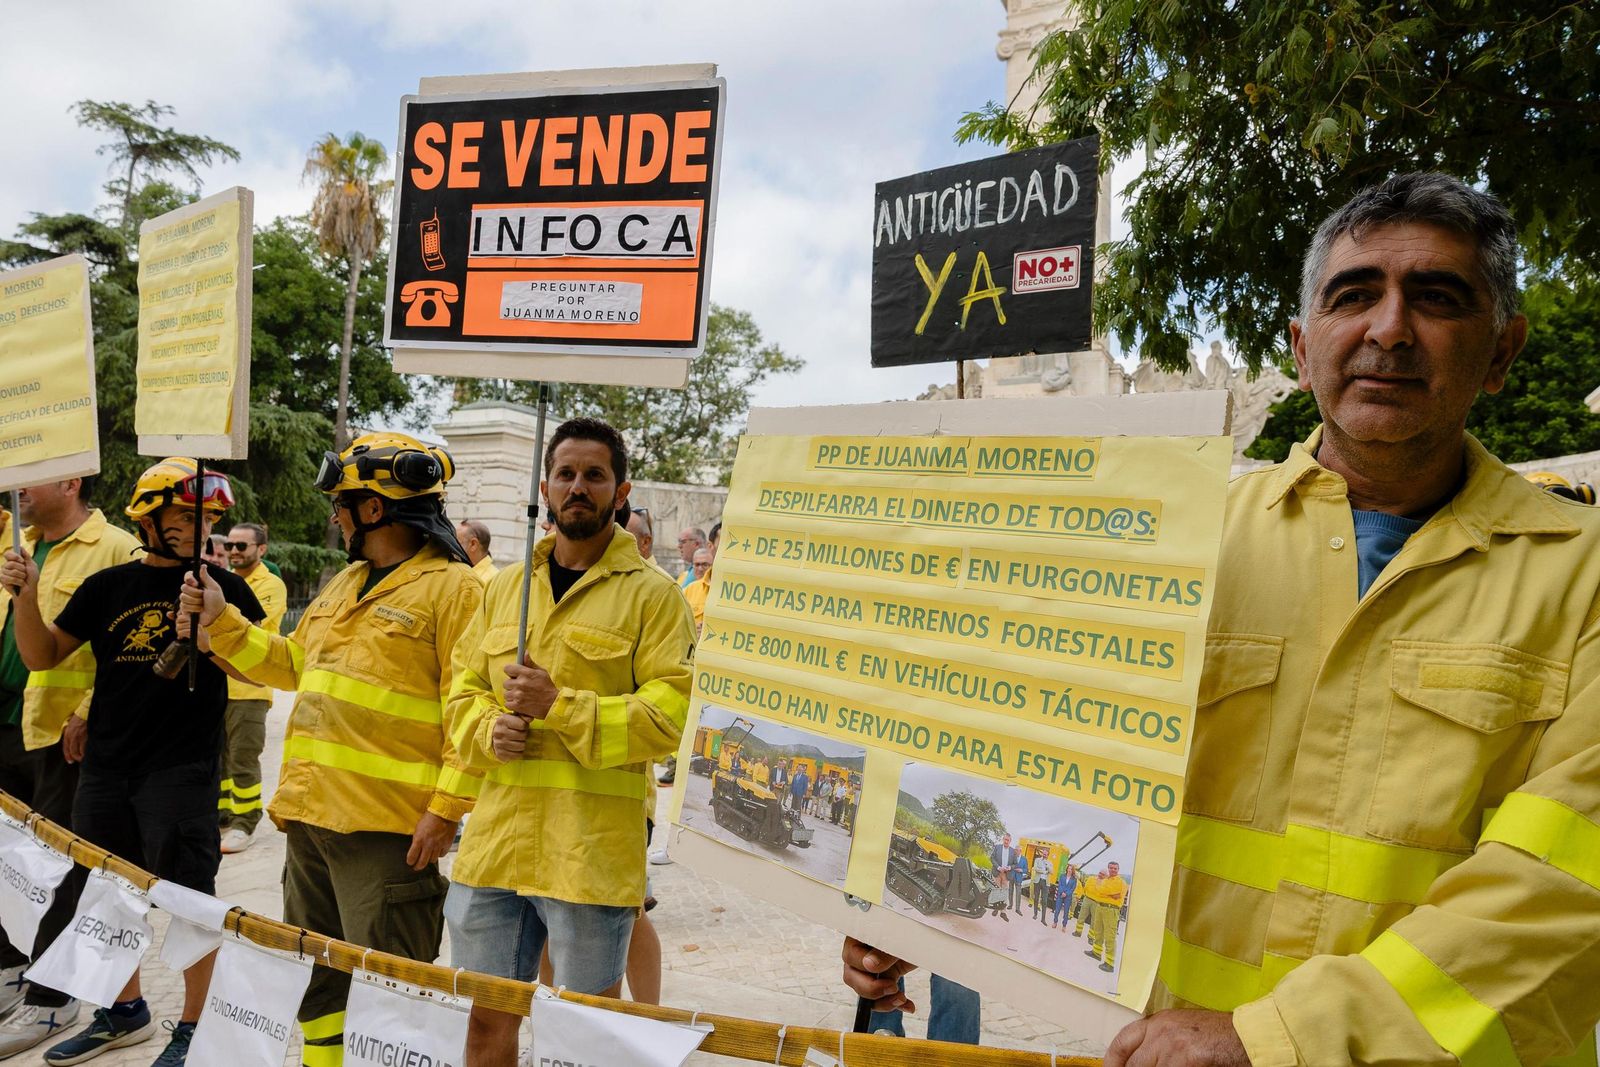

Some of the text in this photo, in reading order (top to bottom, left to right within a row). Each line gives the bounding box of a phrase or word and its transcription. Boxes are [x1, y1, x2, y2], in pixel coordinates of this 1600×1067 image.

[410, 110, 712, 191] SE VENDE
[875, 162, 1080, 248] ANTIGÜEDAD
[472, 213, 694, 253] INFOCA
[1018, 274, 1074, 287] PRECARIEDAD
[1019, 256, 1074, 280] NO+
[4, 277, 44, 296] MORENO
[161, 285, 185, 300] MILLONES
[204, 272, 233, 290] CAMIONES
[530, 282, 616, 294] PREGUNTAR
[914, 251, 1007, 336] YA
[503, 307, 640, 322] JUANMA MORENO
[557, 295, 585, 306] POR
[181, 314, 192, 327] CON
[192, 308, 223, 325] PROBLEMAS
[199, 371, 229, 384] SEGURIDAD
[40, 405, 51, 416] DE
[53, 397, 92, 413] CALIDAD
[816, 444, 1096, 472] PP DE JUANMA MORENO
[758, 489, 1158, 537] DESPILFARRA EL DINERO DE TOD@S:
[755, 536, 779, 558] DE
[783, 540, 804, 561] 25
[806, 541, 905, 574] MILLONES
[910, 552, 940, 578] DE
[945, 556, 961, 580] €
[967, 557, 1000, 584] EN
[1007, 561, 1203, 607] FURGONETAS
[720, 581, 1175, 670] NO APTAS PARA TERRENOS FORESTALES
[732, 630, 756, 652] DE
[758, 635, 792, 660] 800
[795, 642, 830, 669] MIL
[835, 650, 849, 672] €
[859, 654, 888, 680] EN
[895, 659, 1027, 710] VEHÍCULOS
[1039, 687, 1182, 744] TÁCTICOS
[698, 671, 1176, 814] QUE SOLO HAN SERVIDO PARA ESTA FOTO
[346, 1031, 453, 1067] ANTIGÜED
